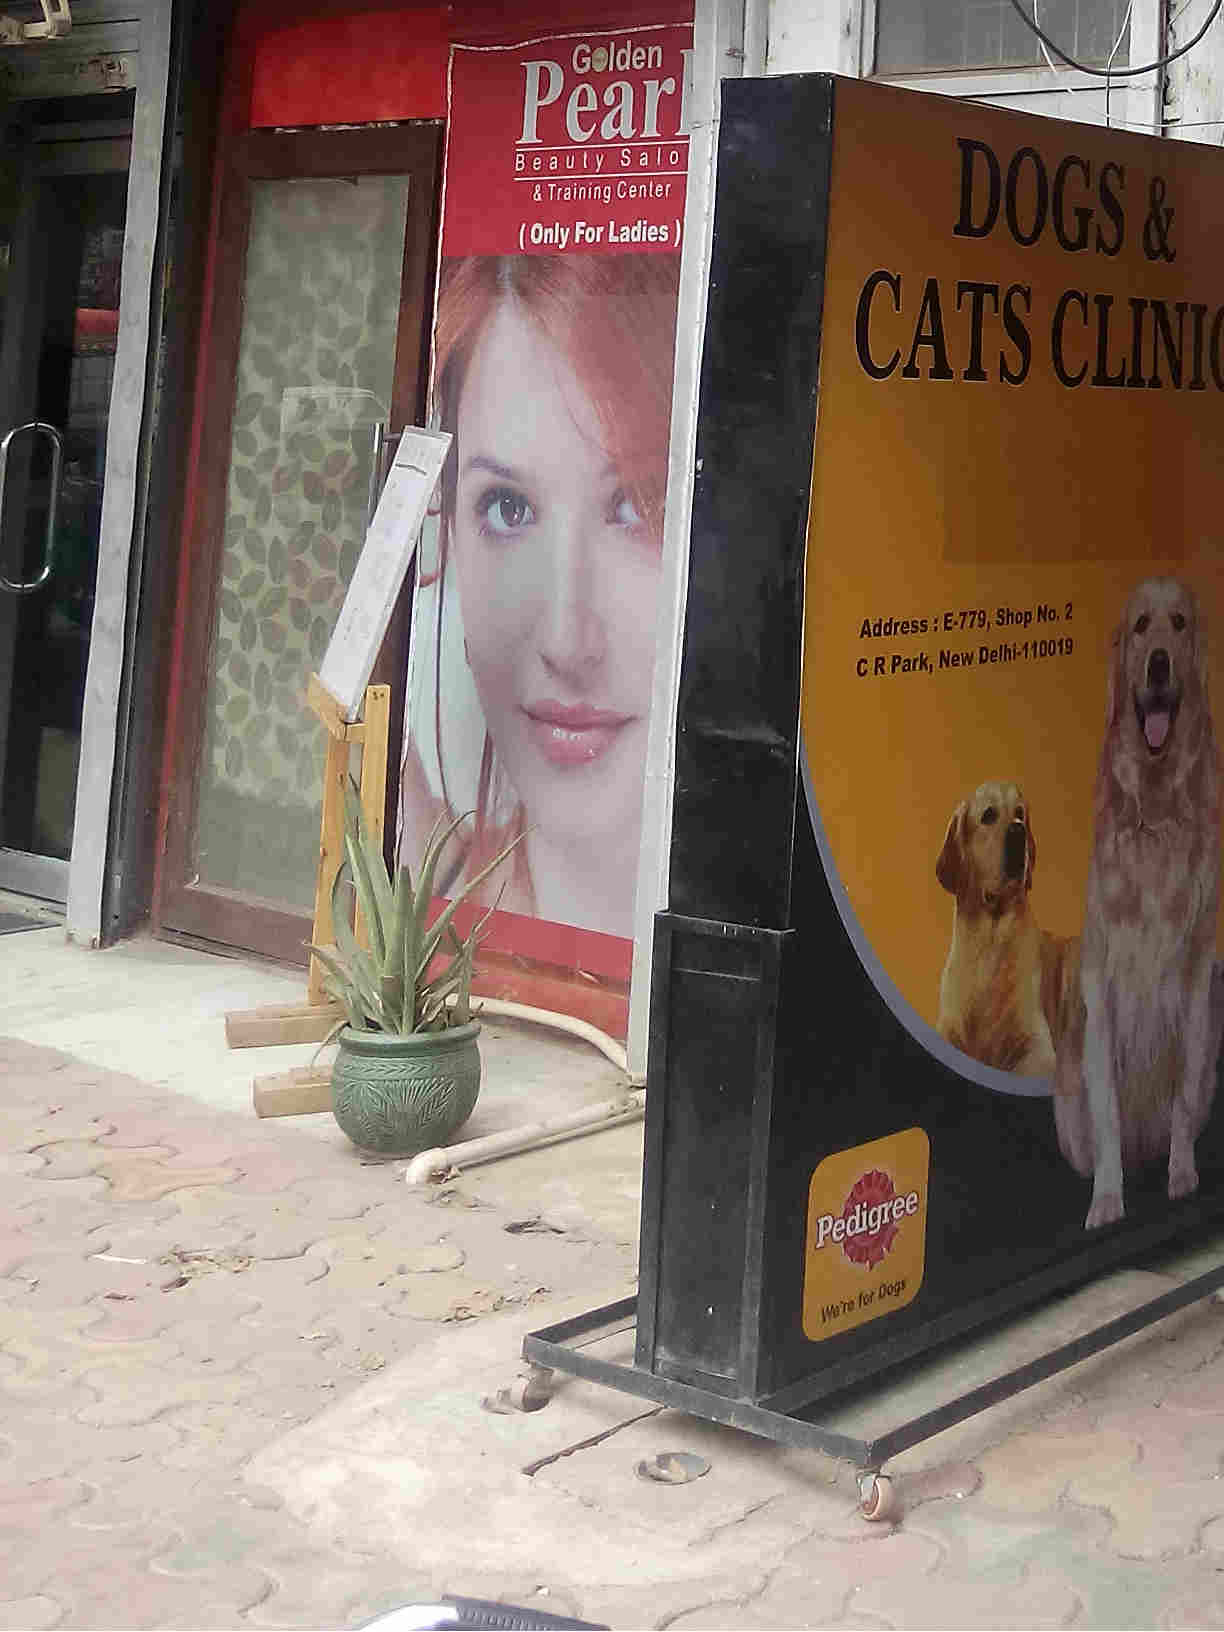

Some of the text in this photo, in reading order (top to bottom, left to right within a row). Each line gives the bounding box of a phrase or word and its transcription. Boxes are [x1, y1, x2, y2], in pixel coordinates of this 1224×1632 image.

[572, 40, 663, 74] Golden
[515, 148, 680, 173] Beauty Salo
[532, 180, 672, 204] & Training Center
[952, 136, 1177, 264] DOGS &
[574, 221, 602, 244] For
[855, 269, 1033, 387] CATS
[859, 617, 929, 639] Address
[995, 607, 1033, 629] Shop
[1037, 604, 1060, 624] No.
[1064, 601, 1073, 620] 2
[856, 658, 868, 677] C
[874, 656, 885, 676] R
[891, 652, 934, 674] Park,
[938, 649, 974, 669] New
[816, 1191, 920, 1249] Pedigree
[858, 1291, 876, 1310] for
[878, 1278, 907, 1299] Dogs
